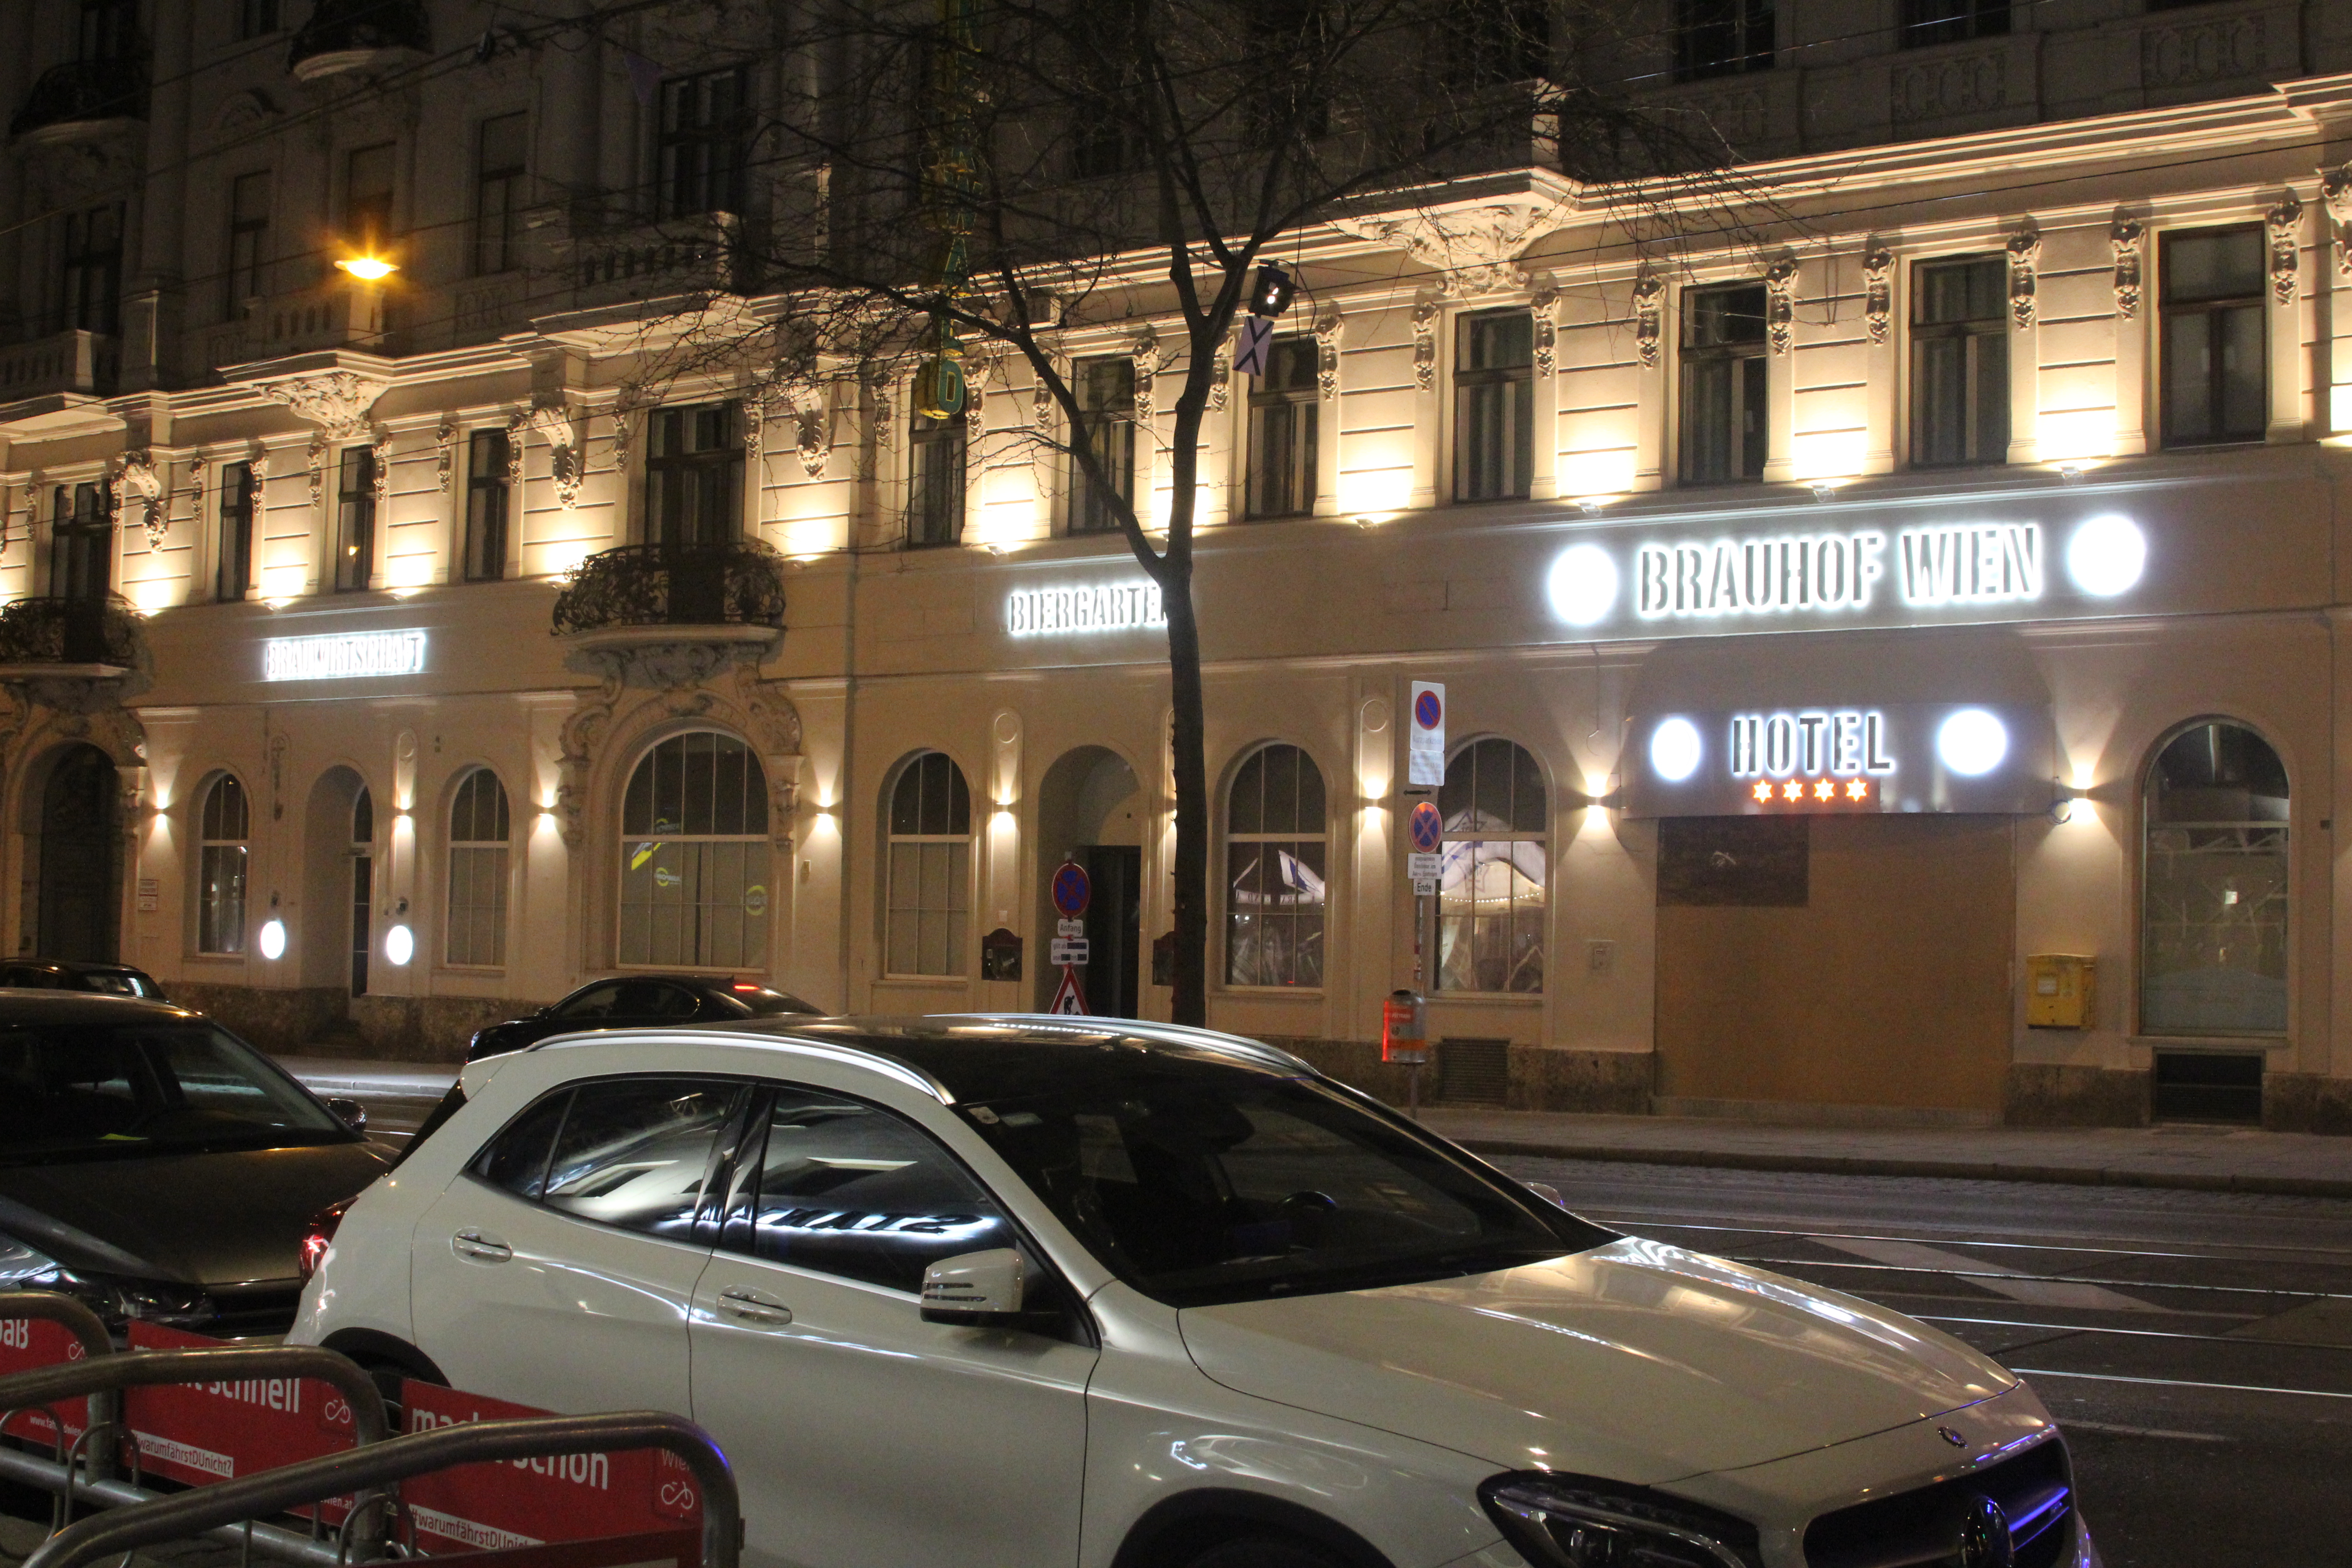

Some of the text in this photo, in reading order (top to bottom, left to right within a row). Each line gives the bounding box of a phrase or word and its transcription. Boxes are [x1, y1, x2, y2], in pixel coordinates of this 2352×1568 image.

[1642, 527, 2034, 612] BRAUHOF WIEN
[1011, 586, 1168, 632] BIERGARTE
[267, 637, 421, 676] BRAUWIRTSCHAFT
[1733, 715, 1891, 773] HOTEL
[1417, 882, 1431, 892] Ende
[1060, 924, 1081, 934] Anfang
